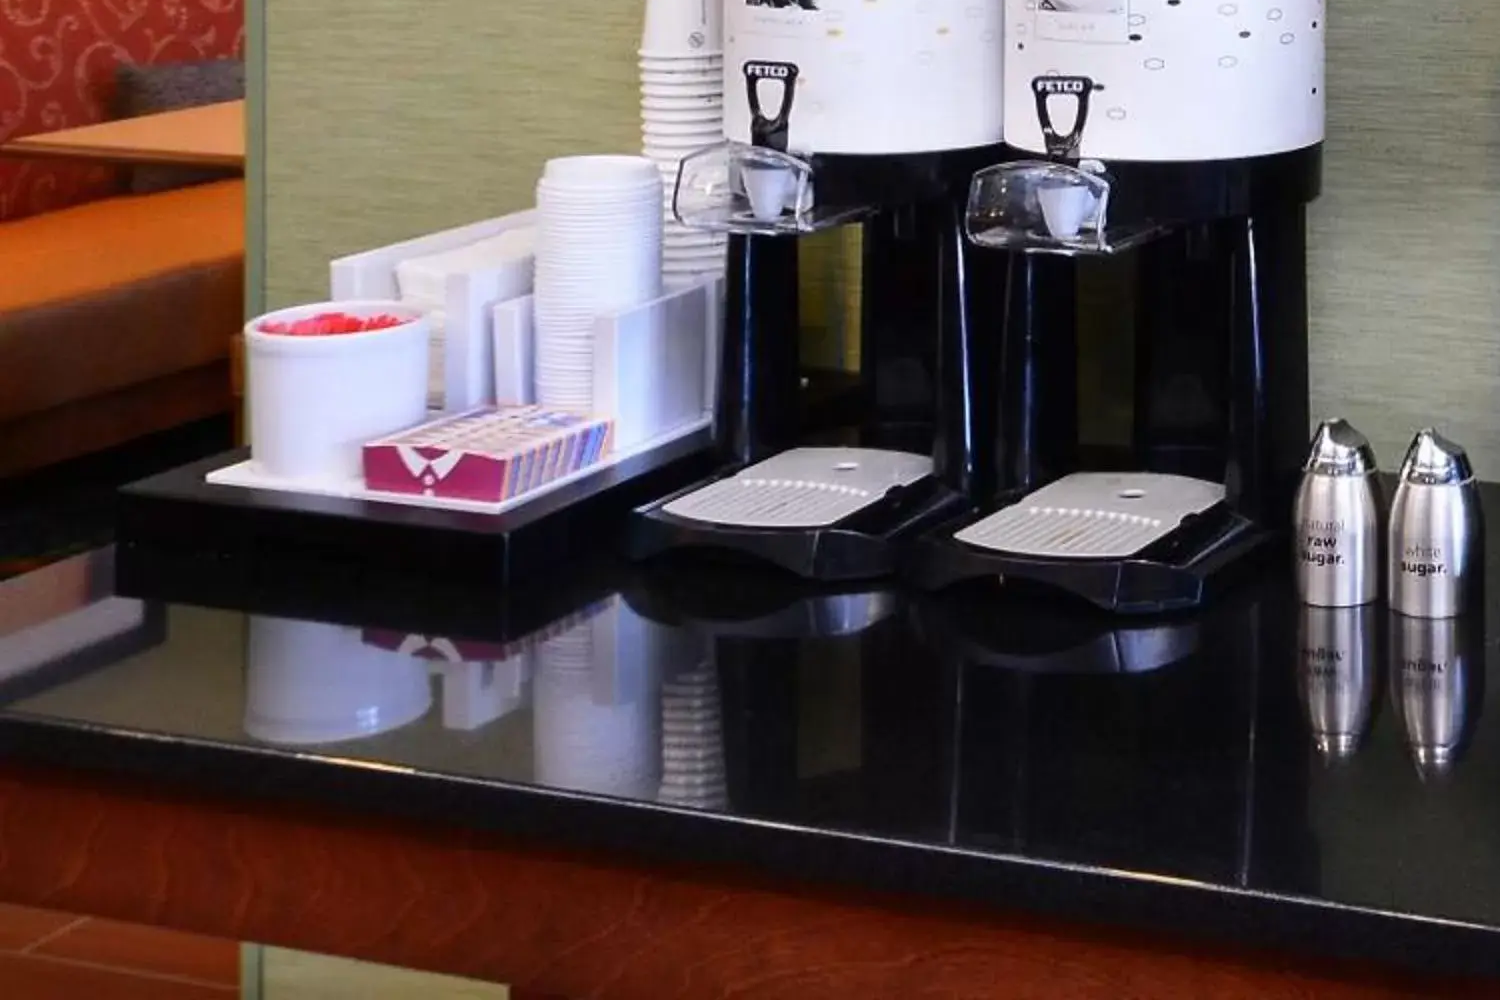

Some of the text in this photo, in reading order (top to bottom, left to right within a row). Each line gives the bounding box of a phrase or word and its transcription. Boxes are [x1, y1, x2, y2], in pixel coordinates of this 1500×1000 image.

[747, 63, 789, 77] FETCO
[1037, 80, 1083, 93] FETCO
[1307, 535, 1337, 549] raw
[1401, 559, 1448, 577] sugar.
